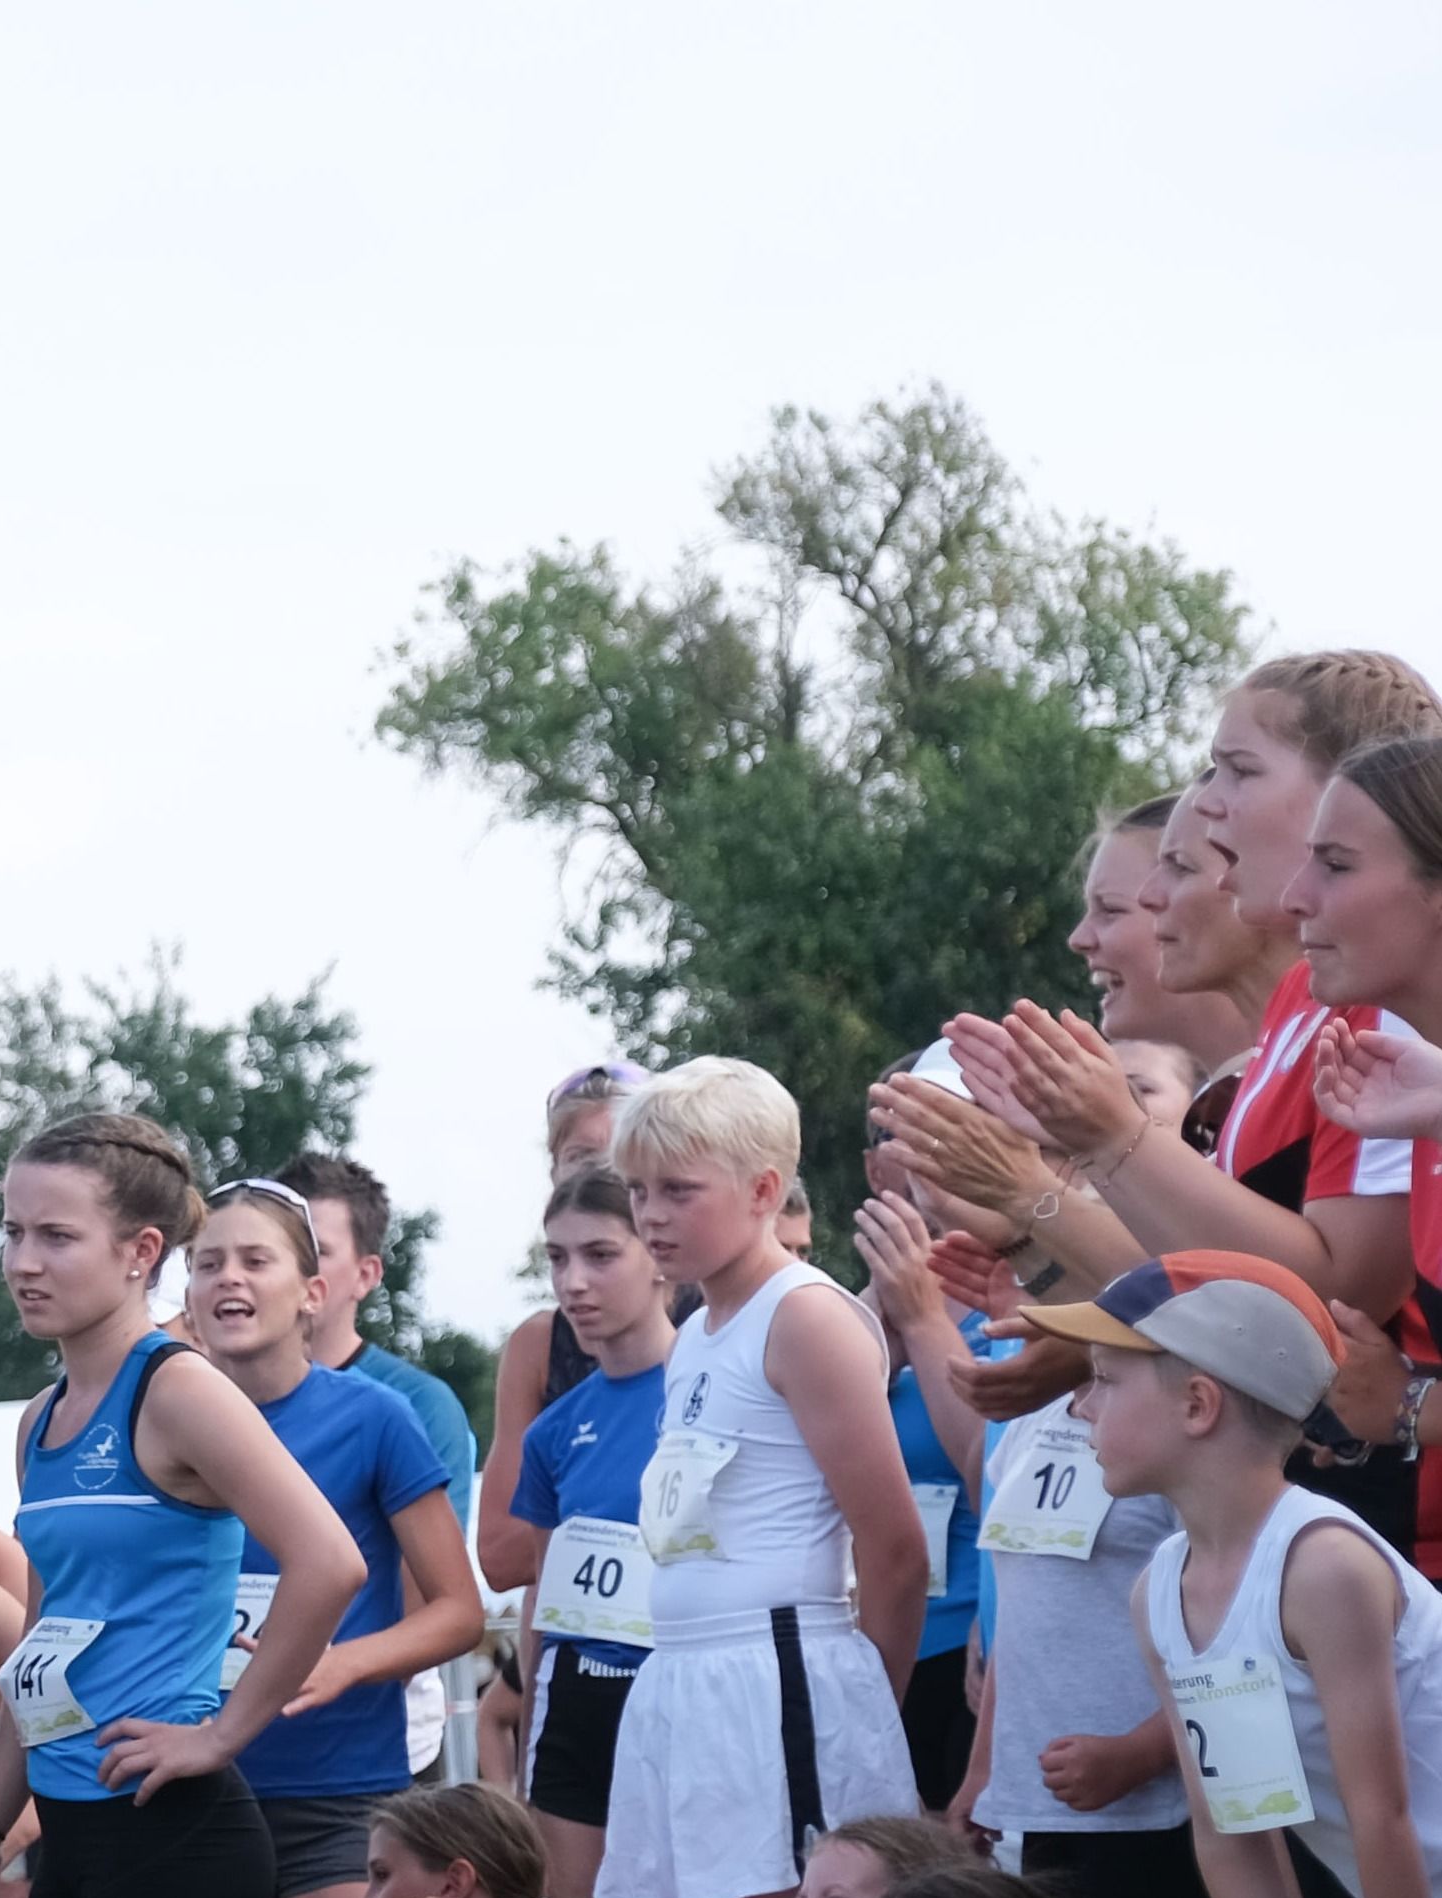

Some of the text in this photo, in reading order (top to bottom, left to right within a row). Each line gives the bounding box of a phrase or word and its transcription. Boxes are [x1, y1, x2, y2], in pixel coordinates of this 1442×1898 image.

[657, 1470, 683, 1518] 16
[1033, 1462, 1077, 1510] 10
[573, 1553, 623, 1598] 40
[13, 1653, 57, 1700] 141
